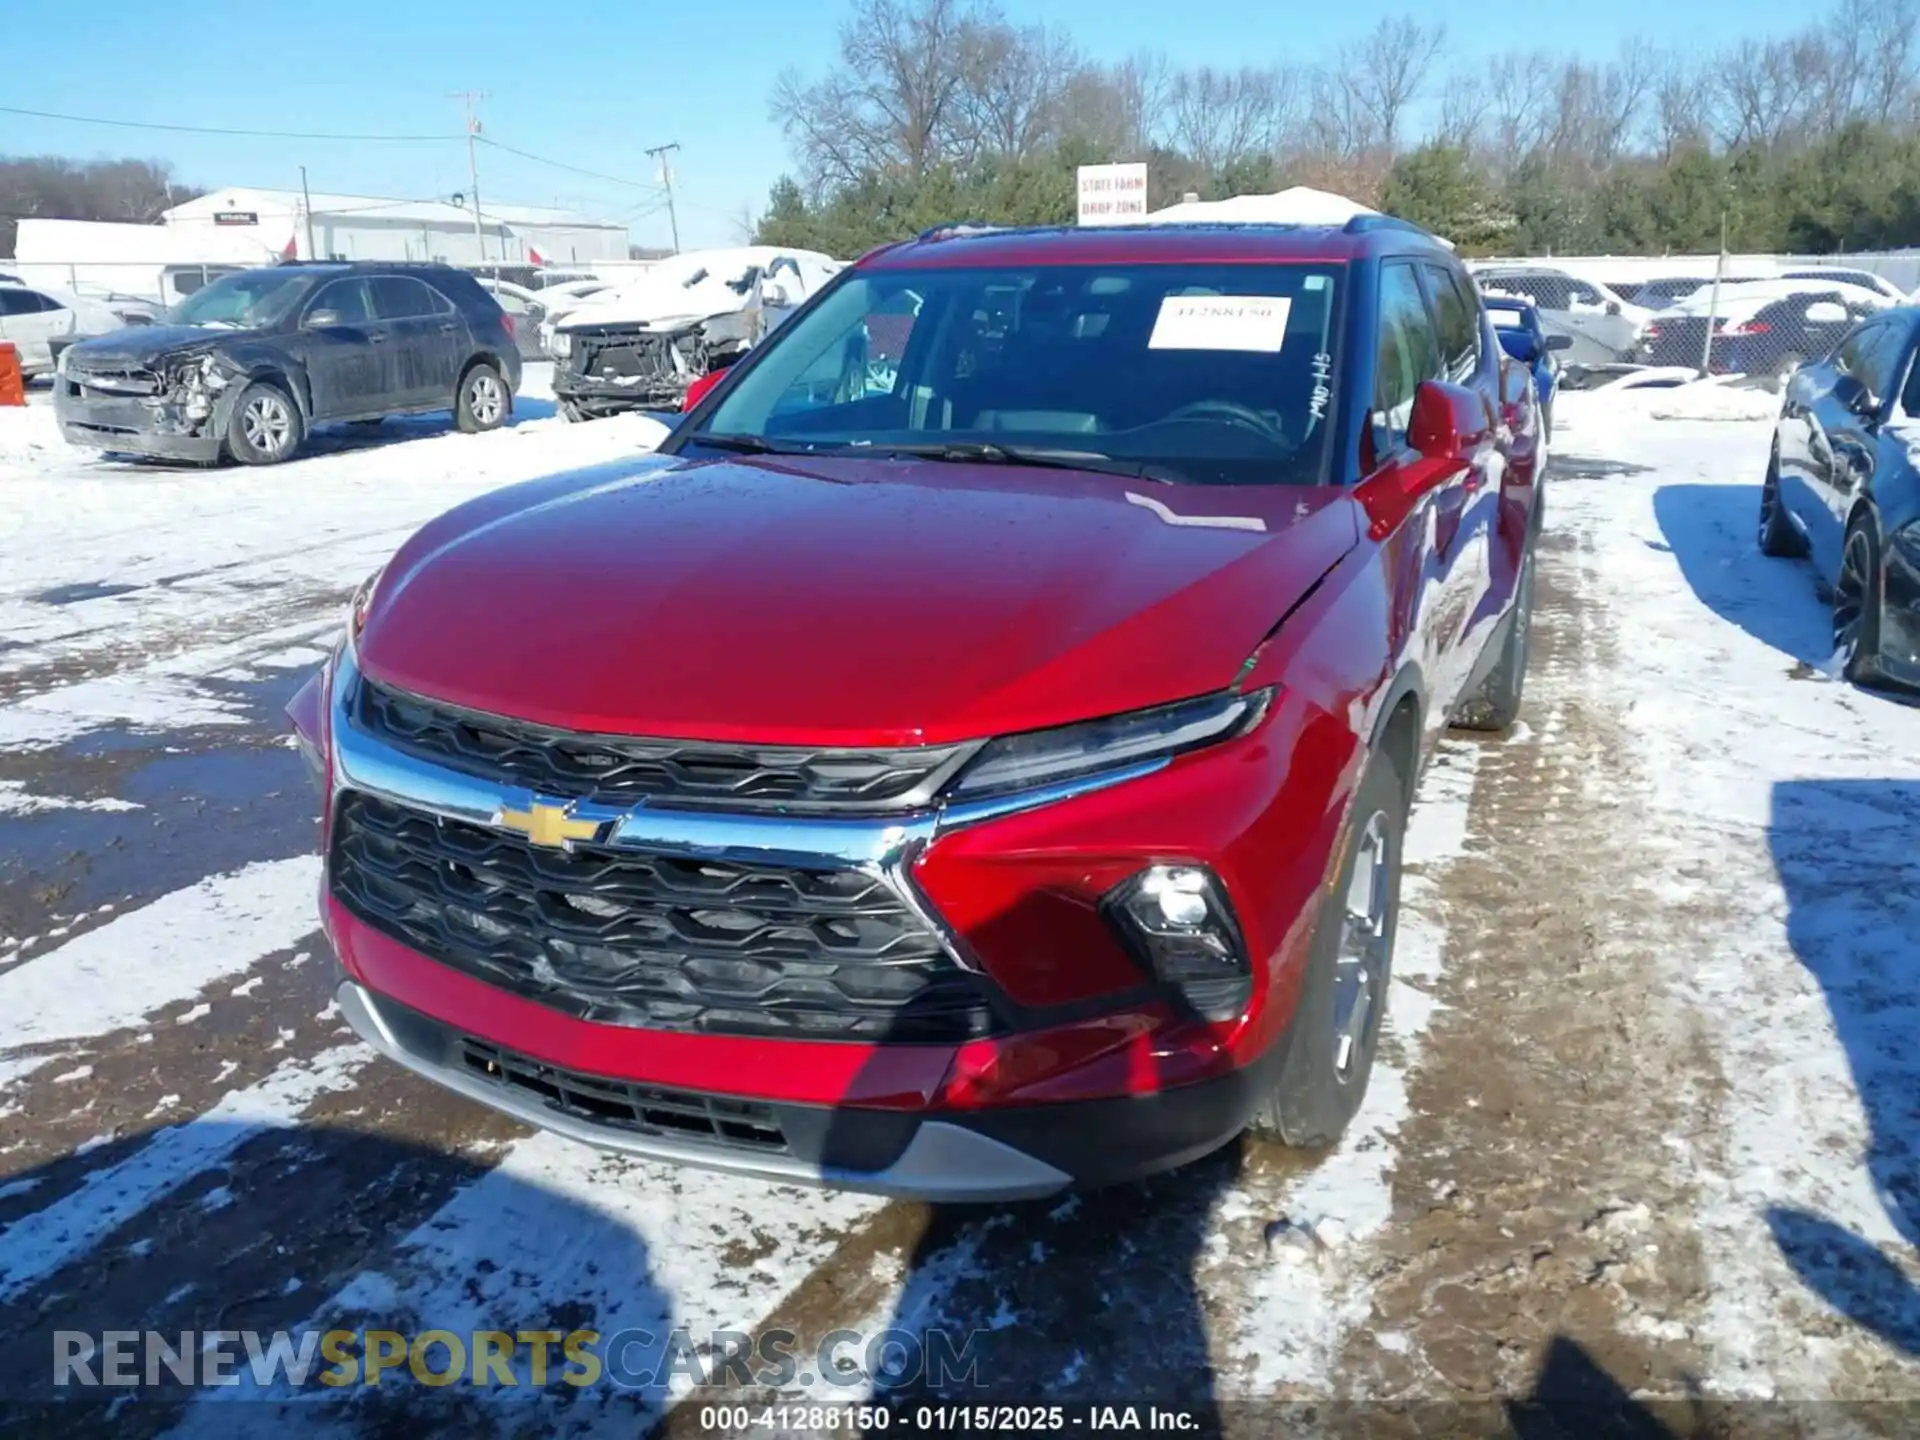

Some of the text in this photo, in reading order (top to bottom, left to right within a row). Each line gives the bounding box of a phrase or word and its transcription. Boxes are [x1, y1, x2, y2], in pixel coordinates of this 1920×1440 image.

[1081, 176, 1144, 193] STATE FARM
[1081, 200, 1143, 216] DROP ZONE
